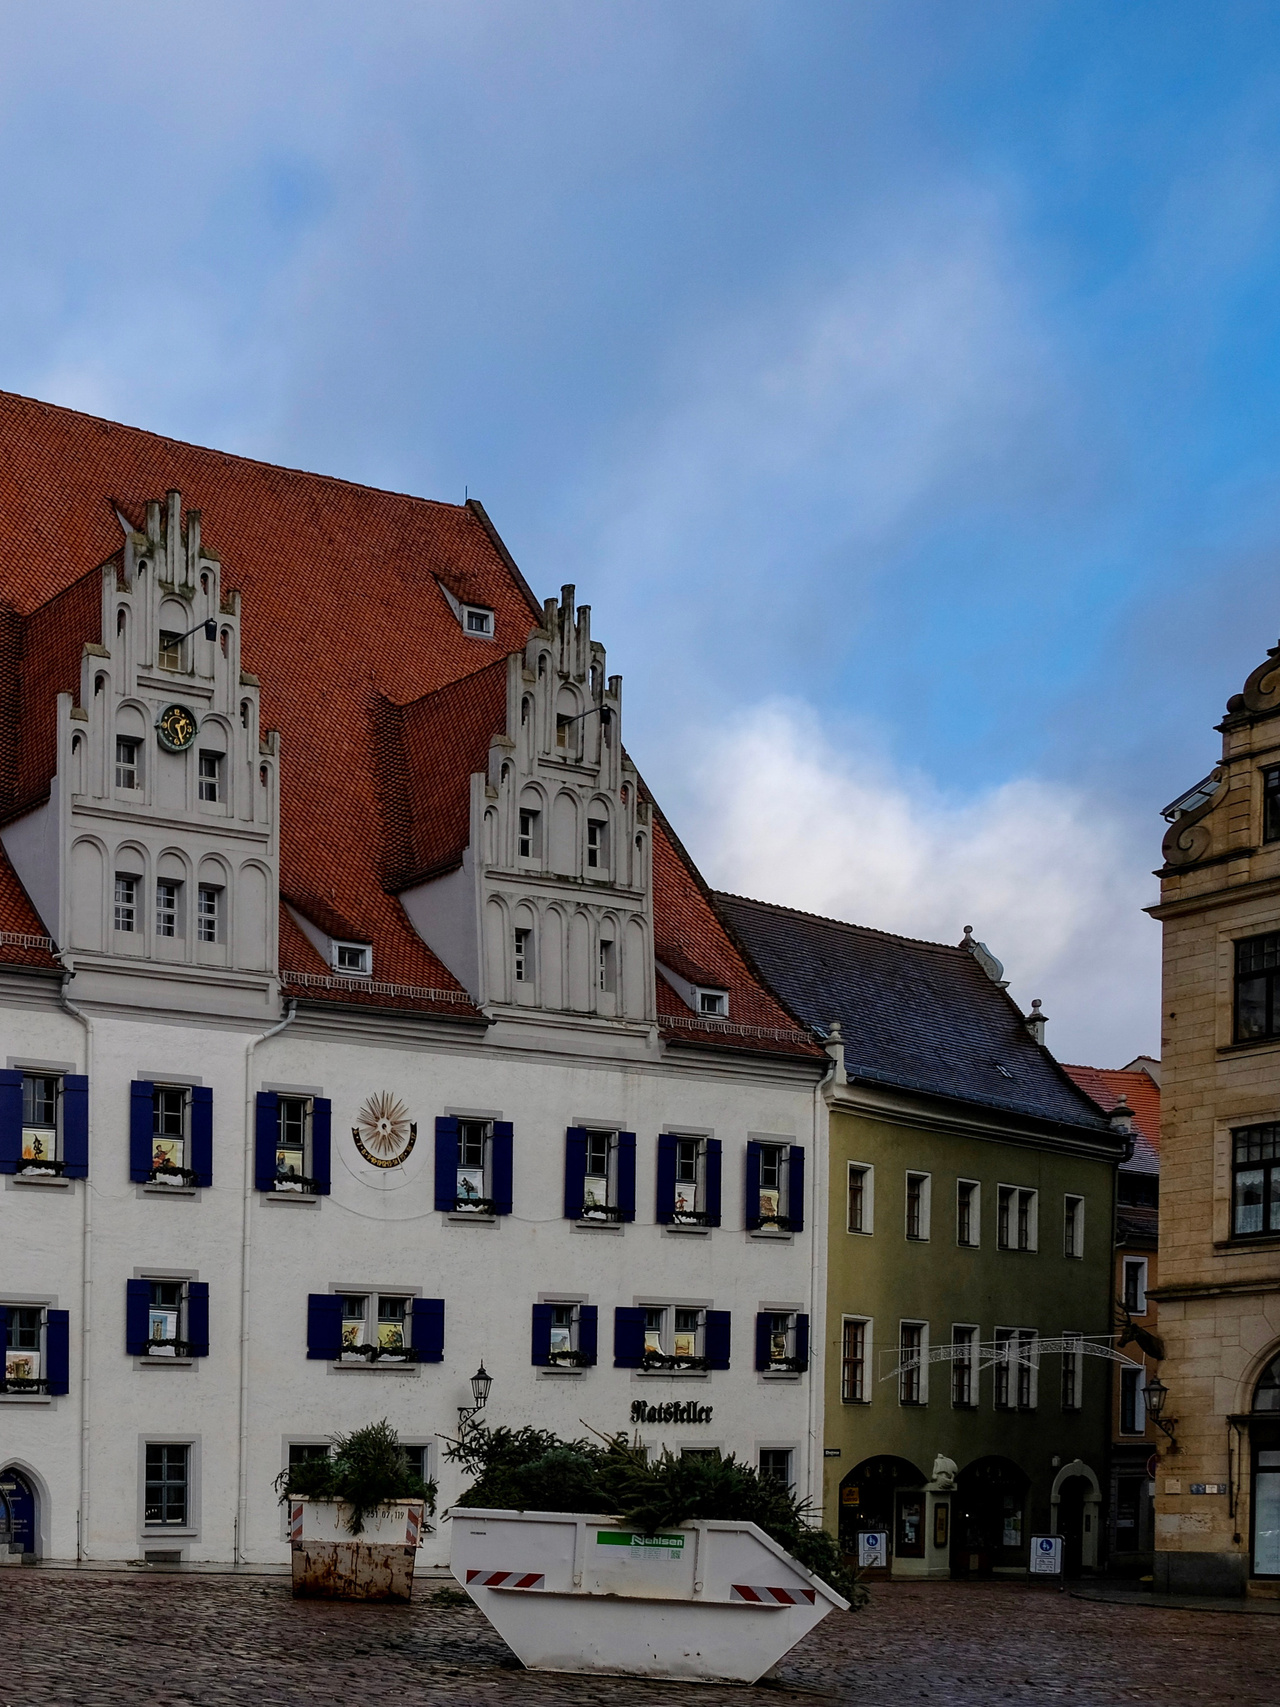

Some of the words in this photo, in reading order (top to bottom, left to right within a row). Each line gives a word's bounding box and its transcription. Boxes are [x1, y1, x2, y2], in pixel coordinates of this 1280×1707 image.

[630, 1400, 713, 1424] Ratskeller
[366, 1510, 378, 1518] 251
[630, 1534, 683, 1546] Nehlsen
